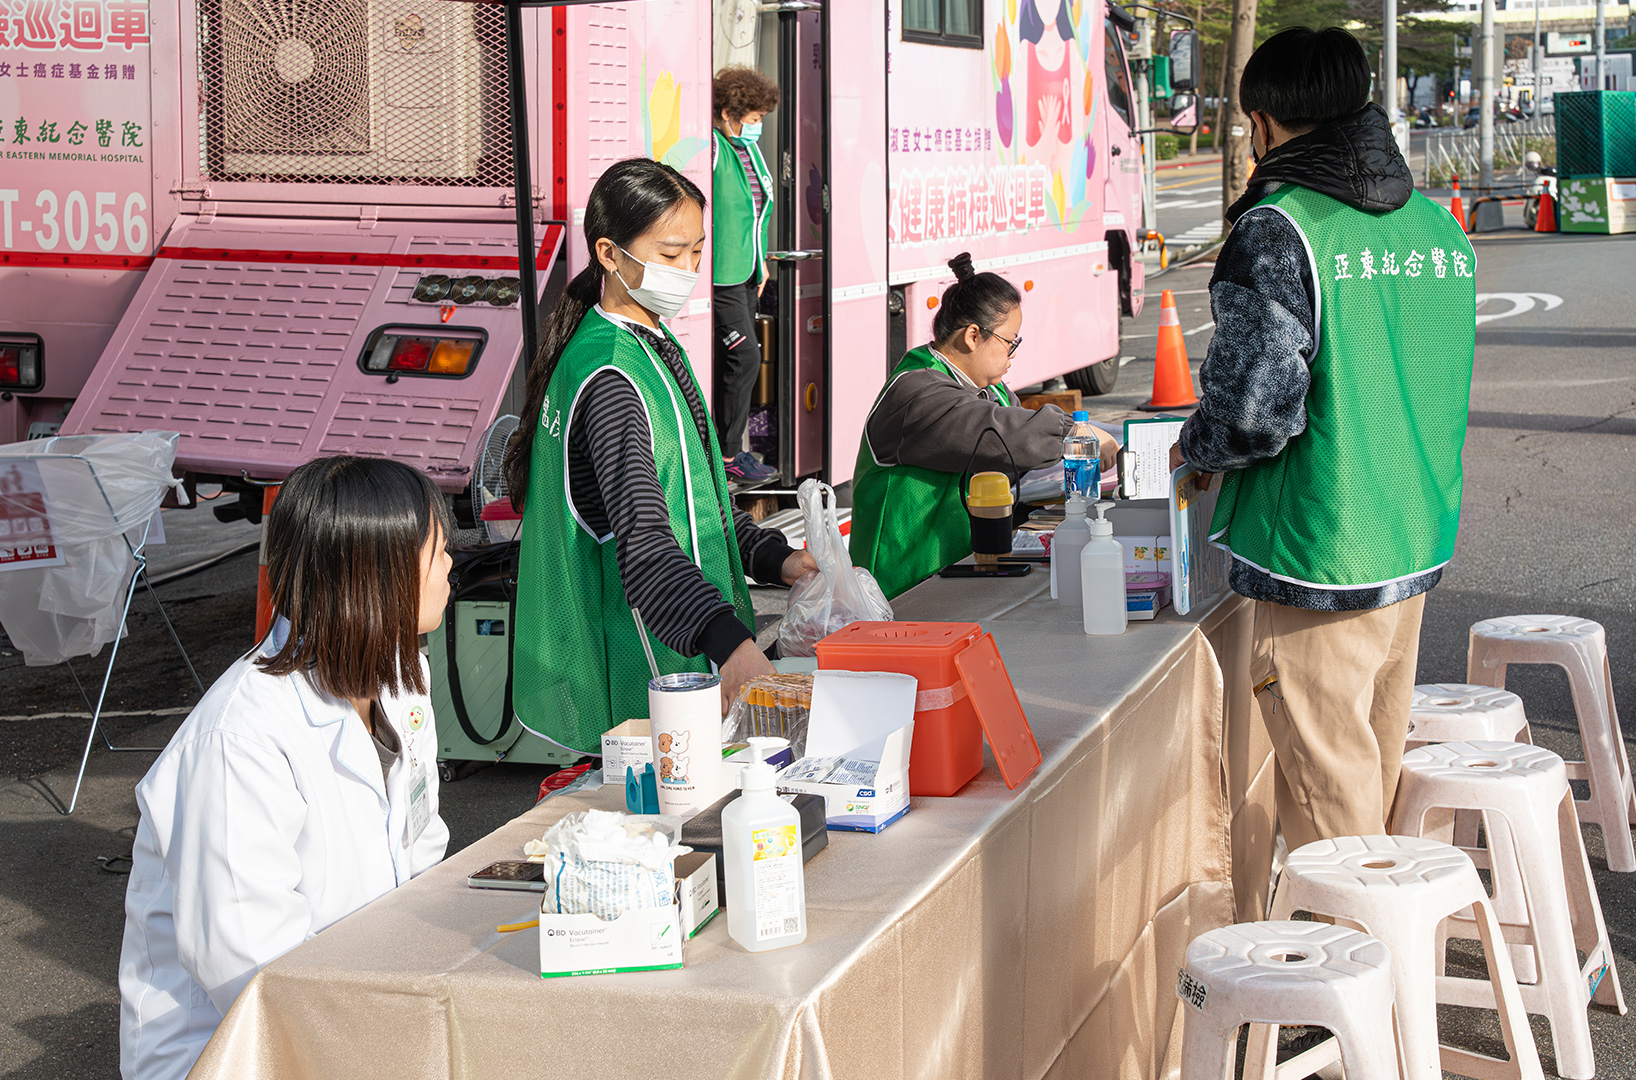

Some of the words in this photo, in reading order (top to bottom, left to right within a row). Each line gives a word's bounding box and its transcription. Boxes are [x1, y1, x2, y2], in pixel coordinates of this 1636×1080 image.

[0, 61, 136, 80] 女士癌症基金捐贈
[0, 116, 144, 148] 東紀念醫院
[6, 151, 46, 160] EASTERN
[48, 152, 98, 162] MEMORIAL
[100, 153, 144, 163] HOSPITAL
[0, 188, 149, 254] T-3056
[1334, 246, 1473, 281] 亞東紀念醫院
[569, 928, 605, 936] Vacutainer
